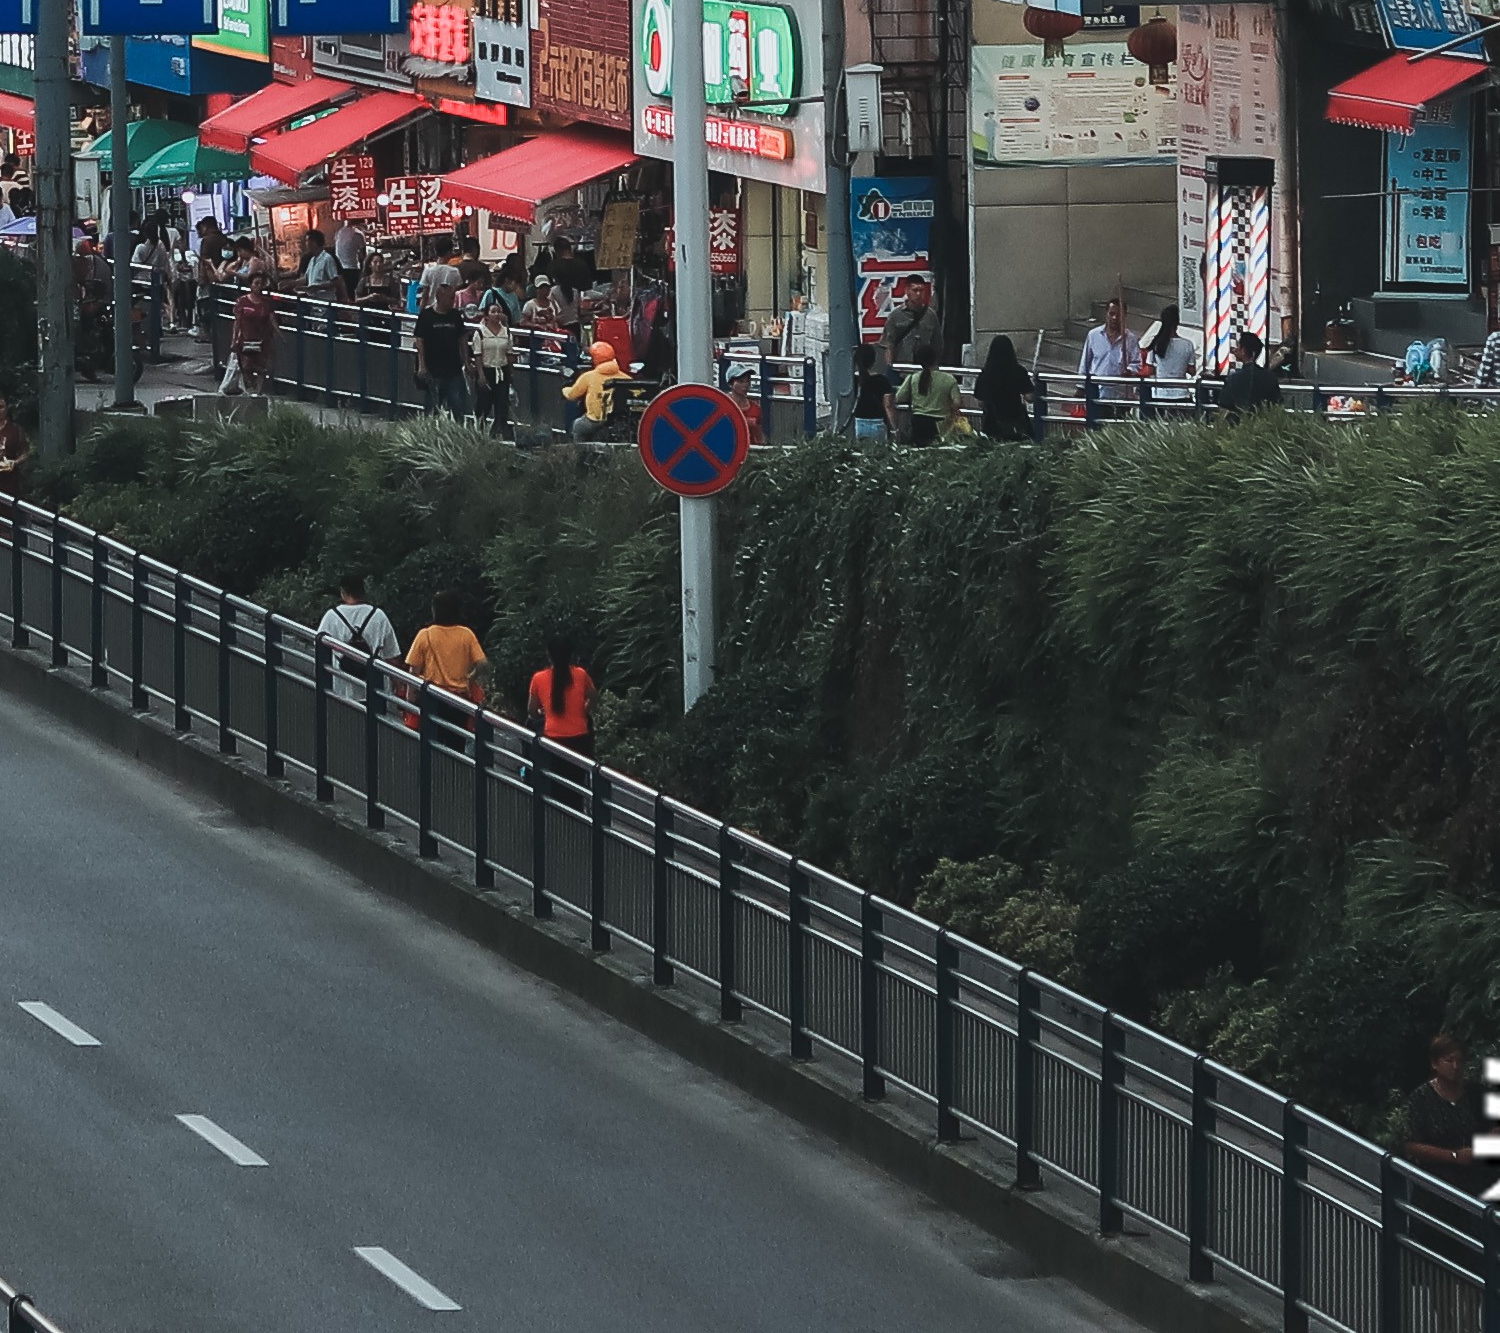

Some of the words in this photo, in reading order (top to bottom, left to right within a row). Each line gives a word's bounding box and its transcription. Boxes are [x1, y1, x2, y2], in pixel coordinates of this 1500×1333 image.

[358, 157, 374, 170] 120
[331, 158, 361, 212] 生漆
[388, 177, 450, 218] 生漆
[361, 198, 377, 210] 170
